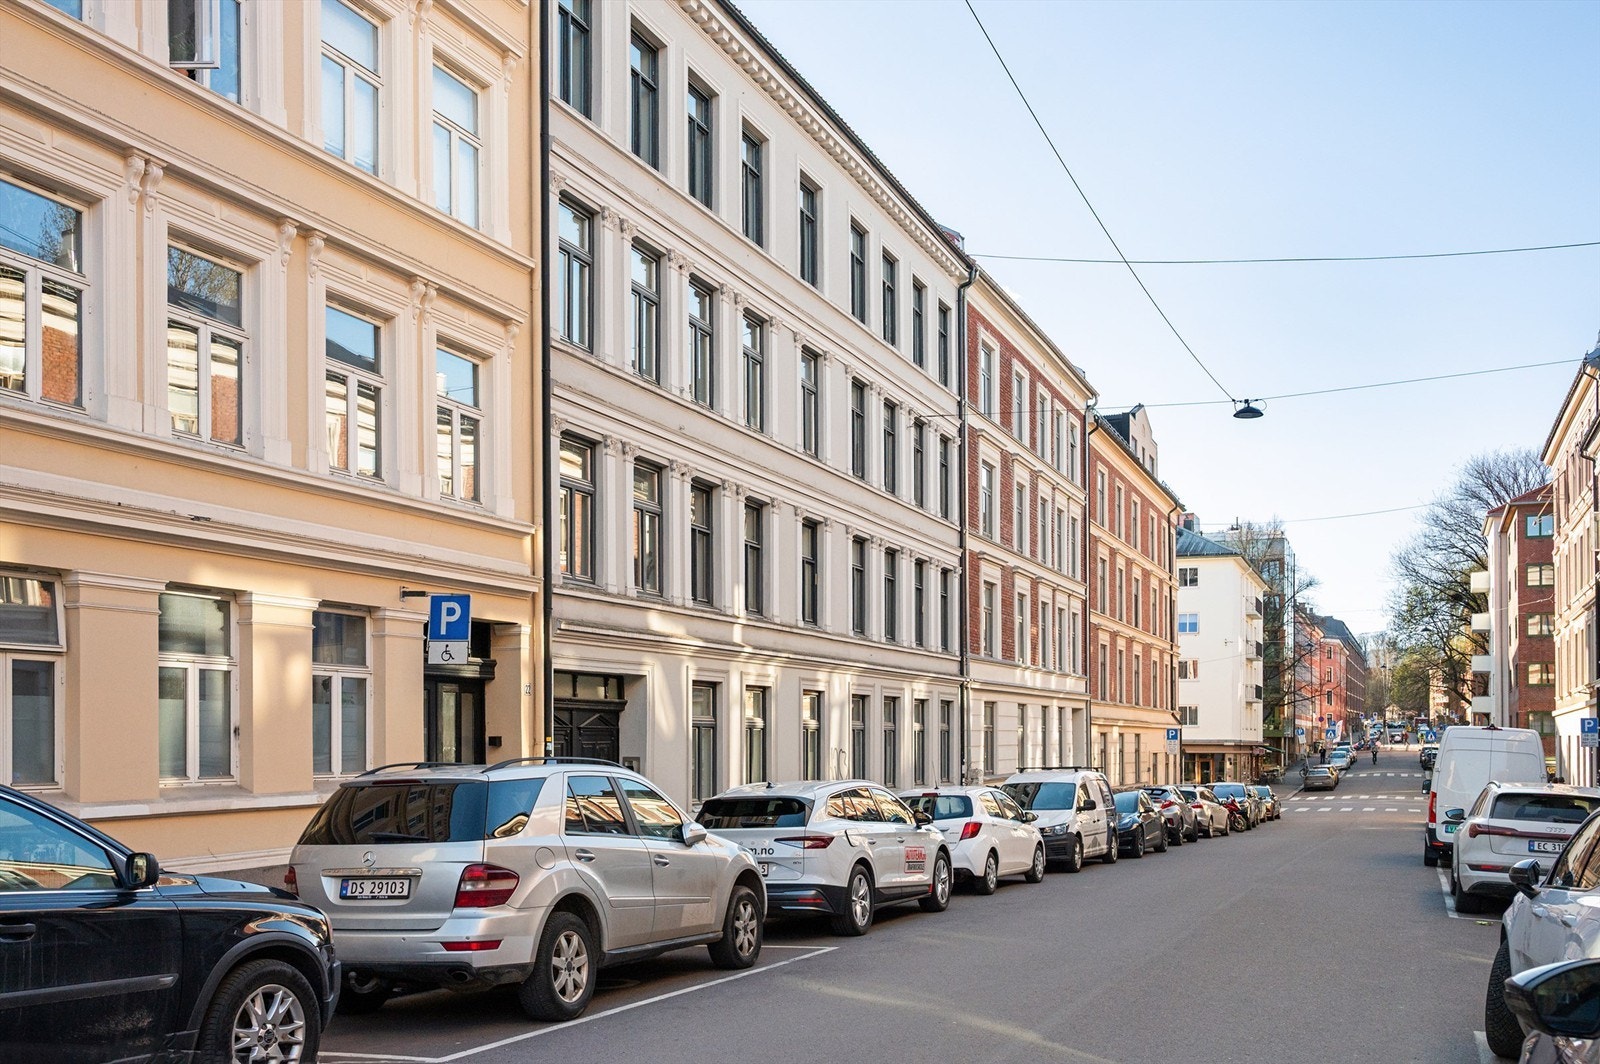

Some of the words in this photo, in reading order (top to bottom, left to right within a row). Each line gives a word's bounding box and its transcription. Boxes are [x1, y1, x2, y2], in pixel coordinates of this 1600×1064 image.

[440, 601, 462, 635] P
[1584, 719, 1594, 732] P
[1168, 730, 1176, 739] P
[1537, 842, 1548, 850] EC
[350, 881, 365, 895] DS
[369, 881, 405, 895] 29103
